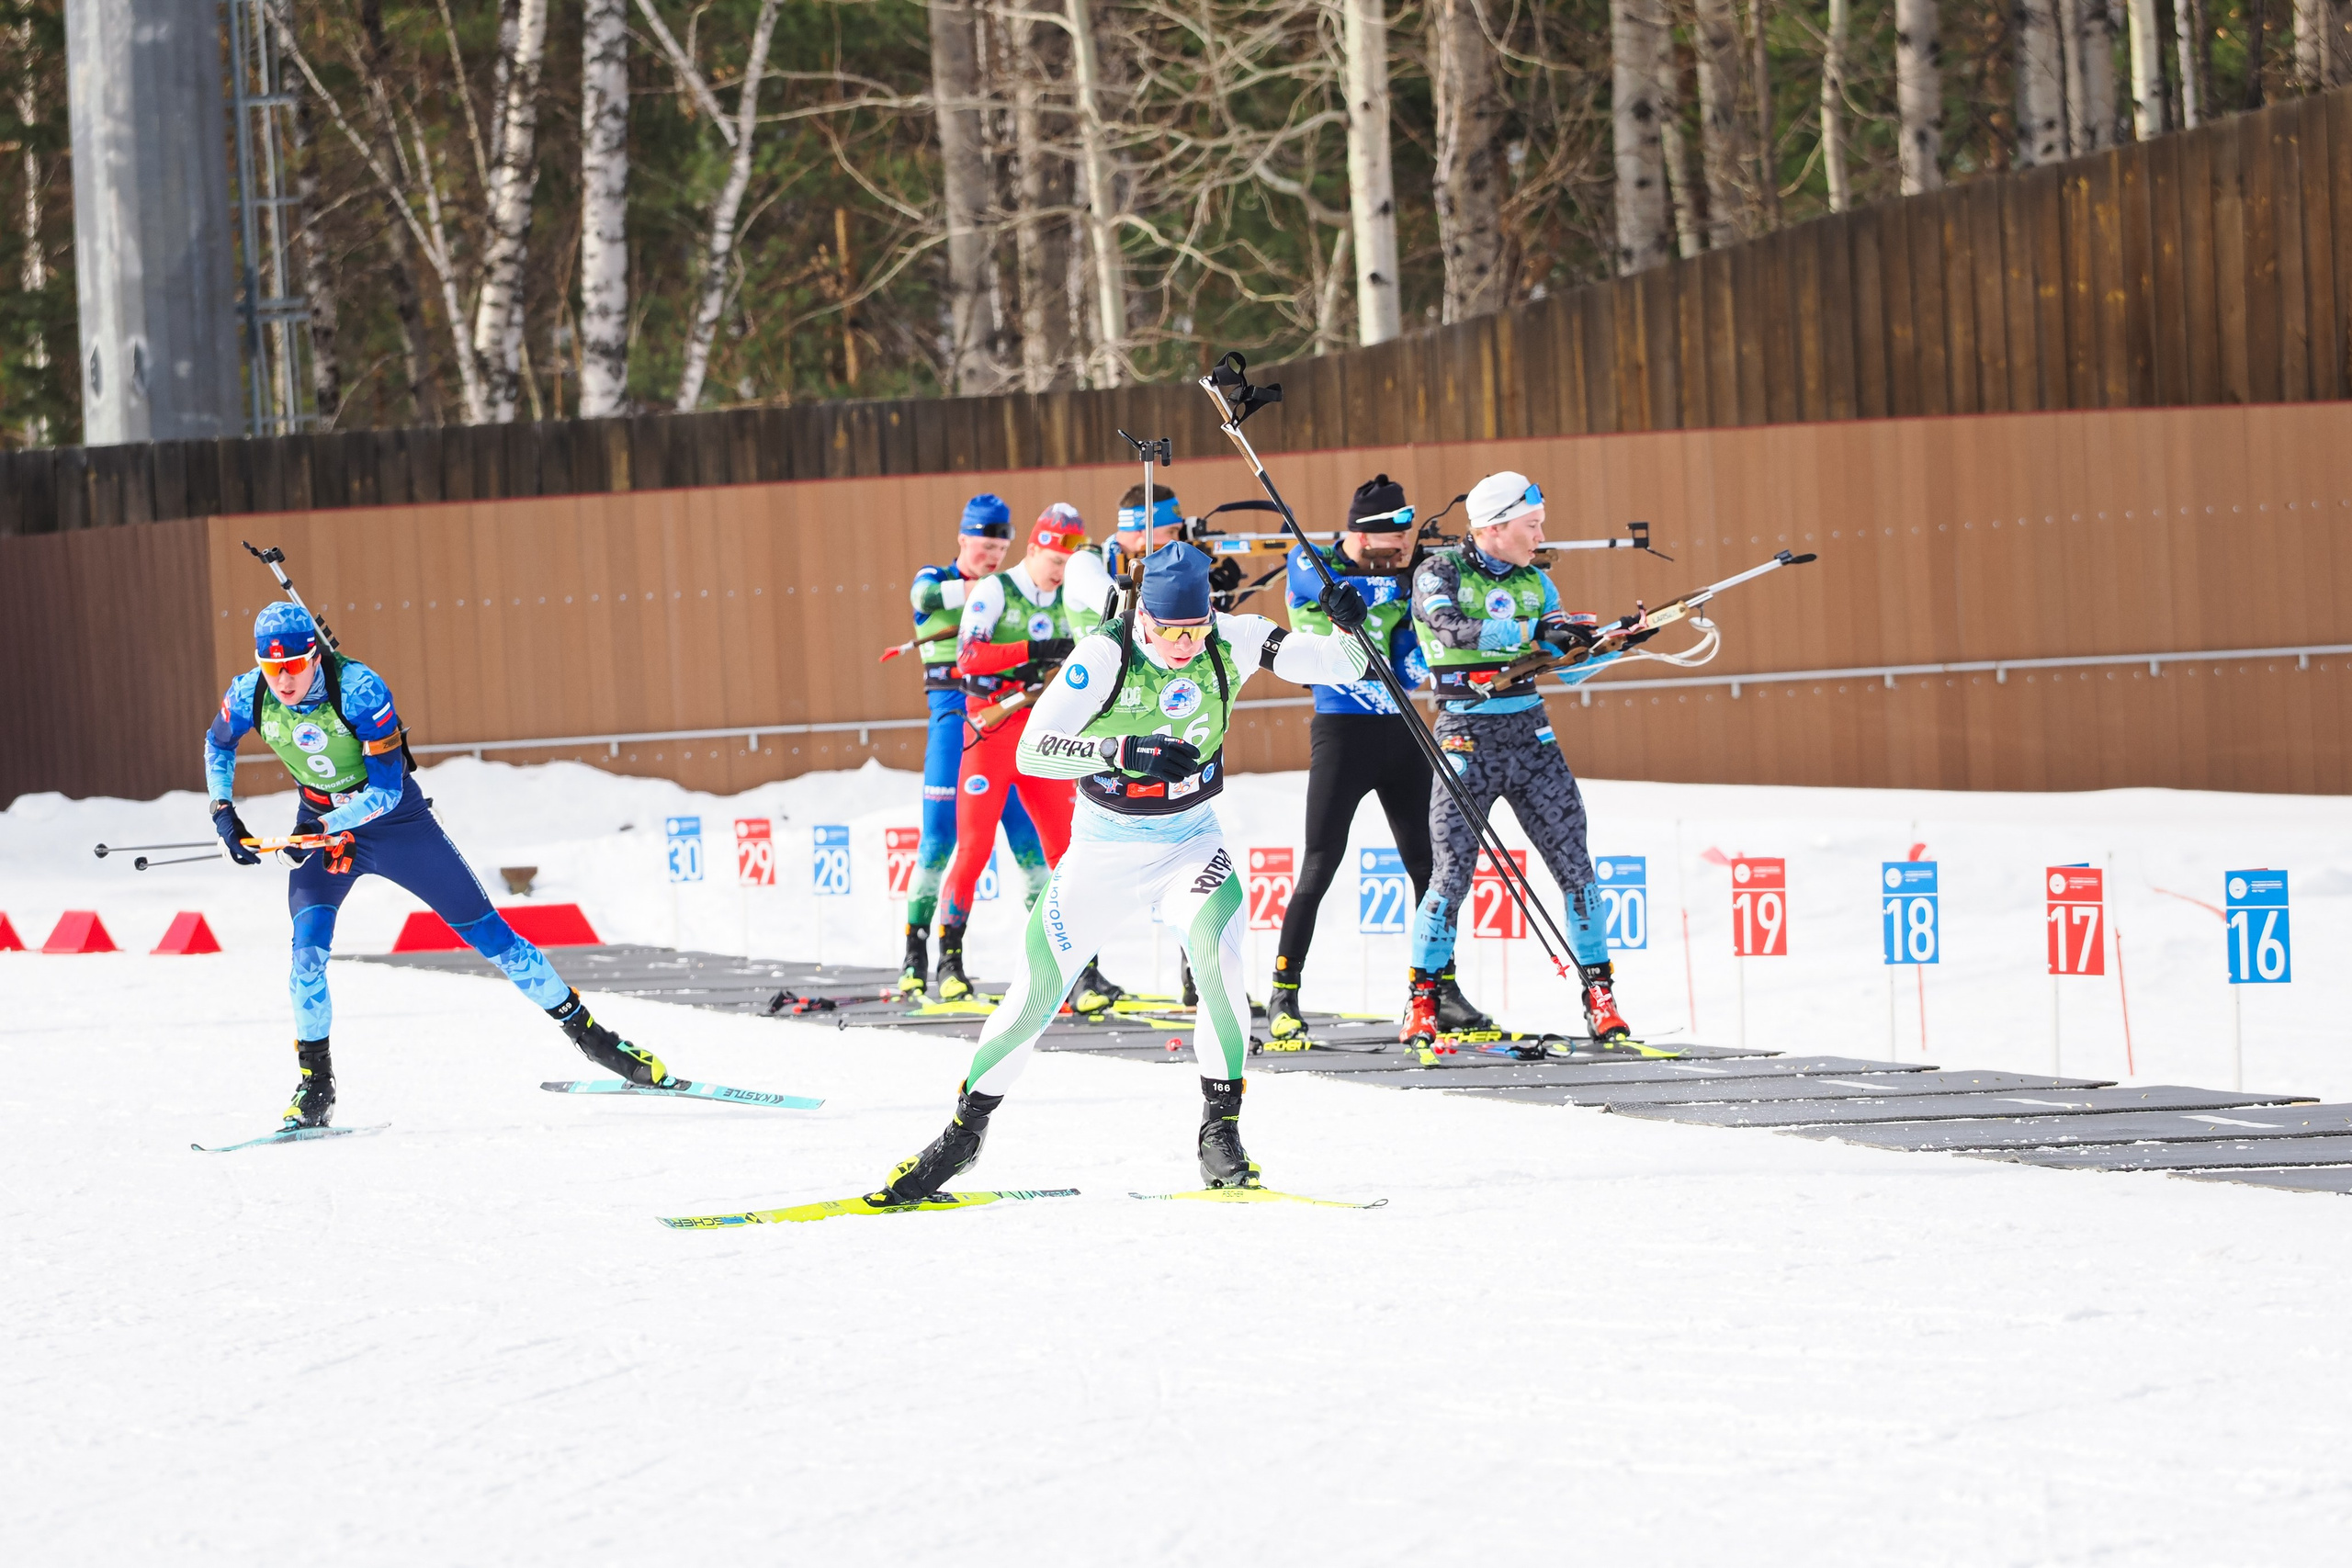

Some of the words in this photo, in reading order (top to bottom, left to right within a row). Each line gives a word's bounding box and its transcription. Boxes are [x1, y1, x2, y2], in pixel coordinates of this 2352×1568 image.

[307, 755, 336, 778] 9
[309, 774, 356, 791] РАСНОЯРСК
[669, 838, 703, 882] 30
[738, 840, 774, 885] 29
[814, 849, 850, 894] 28
[1049, 886, 1072, 952] ЮГОРИЯ
[1250, 876, 1293, 929] 23
[1361, 877, 1405, 932] 22
[1476, 880, 1521, 937] 21
[1600, 888, 1645, 948] 20
[1736, 892, 1783, 954] 19
[1886, 897, 1936, 962] 18
[2050, 906, 2099, 973] 17
[2231, 910, 2286, 980] 16
[559, 1002, 572, 1014] 159
[1213, 1082, 1231, 1092] 166
[673, 1216, 726, 1227] SCHER
